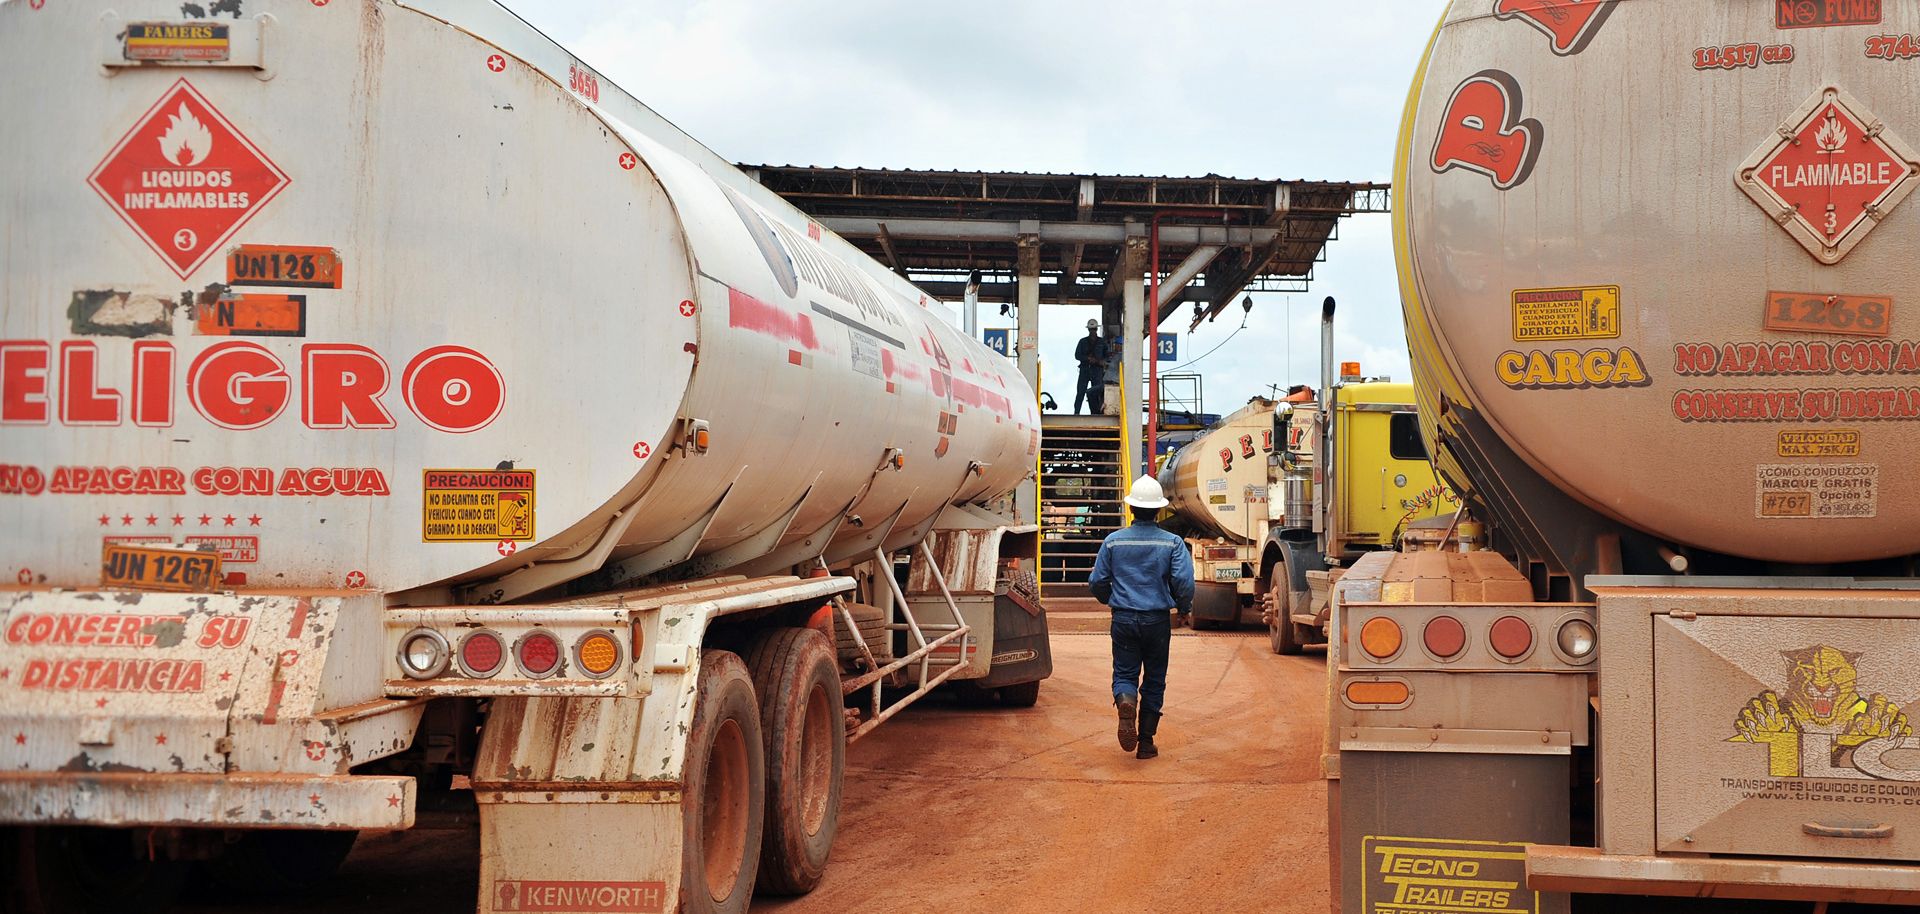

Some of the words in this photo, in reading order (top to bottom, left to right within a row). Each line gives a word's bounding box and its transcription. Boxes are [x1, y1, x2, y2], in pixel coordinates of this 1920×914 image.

[1824, 0, 1878, 22] FUME
[144, 26, 213, 38] FAMERS
[1692, 43, 1759, 70] 11.517
[1864, 34, 1920, 61] 274.
[569, 65, 599, 104] 3650
[142, 170, 232, 188] LIQUIDOS
[1772, 161, 1890, 188] FLAMMABLE
[124, 192, 249, 209] INFLAMABLES
[1824, 211, 1837, 229] 3
[178, 231, 192, 248] 3
[235, 254, 335, 280] UN126
[1772, 298, 1886, 329] 1268
[1520, 326, 1580, 336] DERECHA
[987, 336, 1004, 350] 14
[1158, 340, 1174, 355] 13
[1674, 342, 1718, 376] NO
[1718, 341, 1832, 376] APAGAR
[1832, 340, 1895, 375] CON
[1895, 340, 1920, 375] A
[1495, 347, 1652, 390] CARGA
[1671, 388, 1800, 422] CONSERVE
[1801, 387, 1837, 421] SU
[1782, 433, 1857, 443] VELOCIDAD
[1781, 445, 1814, 454] MAX.
[1819, 444, 1856, 454] 75K/H
[1804, 466, 1876, 476] CONDUZCO?
[0, 465, 45, 496] NO
[49, 466, 186, 496] APAGAR
[192, 467, 274, 496] CON
[278, 468, 391, 497] AGUA
[1762, 480, 1818, 489] MARQUE
[1825, 479, 1872, 488] GRATIS
[430, 494, 440, 506] NO
[481, 494, 495, 506] ESTE
[1767, 496, 1807, 510] #767
[1819, 490, 1861, 501] Opción
[1865, 490, 1871, 499] 3
[428, 509, 456, 521] VEHICULO
[458, 509, 482, 521] CUANDO
[484, 509, 496, 521] ESTE
[427, 524, 455, 536] GIRANDO
[463, 524, 469, 536] LA
[471, 524, 497, 536] DERECHA
[234, 538, 255, 549] MAX.
[109, 551, 148, 581] UN
[153, 555, 215, 586] 1267
[195, 615, 253, 649] SU
[20, 658, 207, 693] DISTANCIA
[1720, 778, 1804, 792] TRANSPORTES
[1805, 781, 1858, 794] LIQUIDOS
[1860, 783, 1876, 794] DE
[1375, 846, 1526, 877] TECNO
[527, 886, 658, 908] KENWORTH
[1384, 875, 1519, 908] TRAILERS
